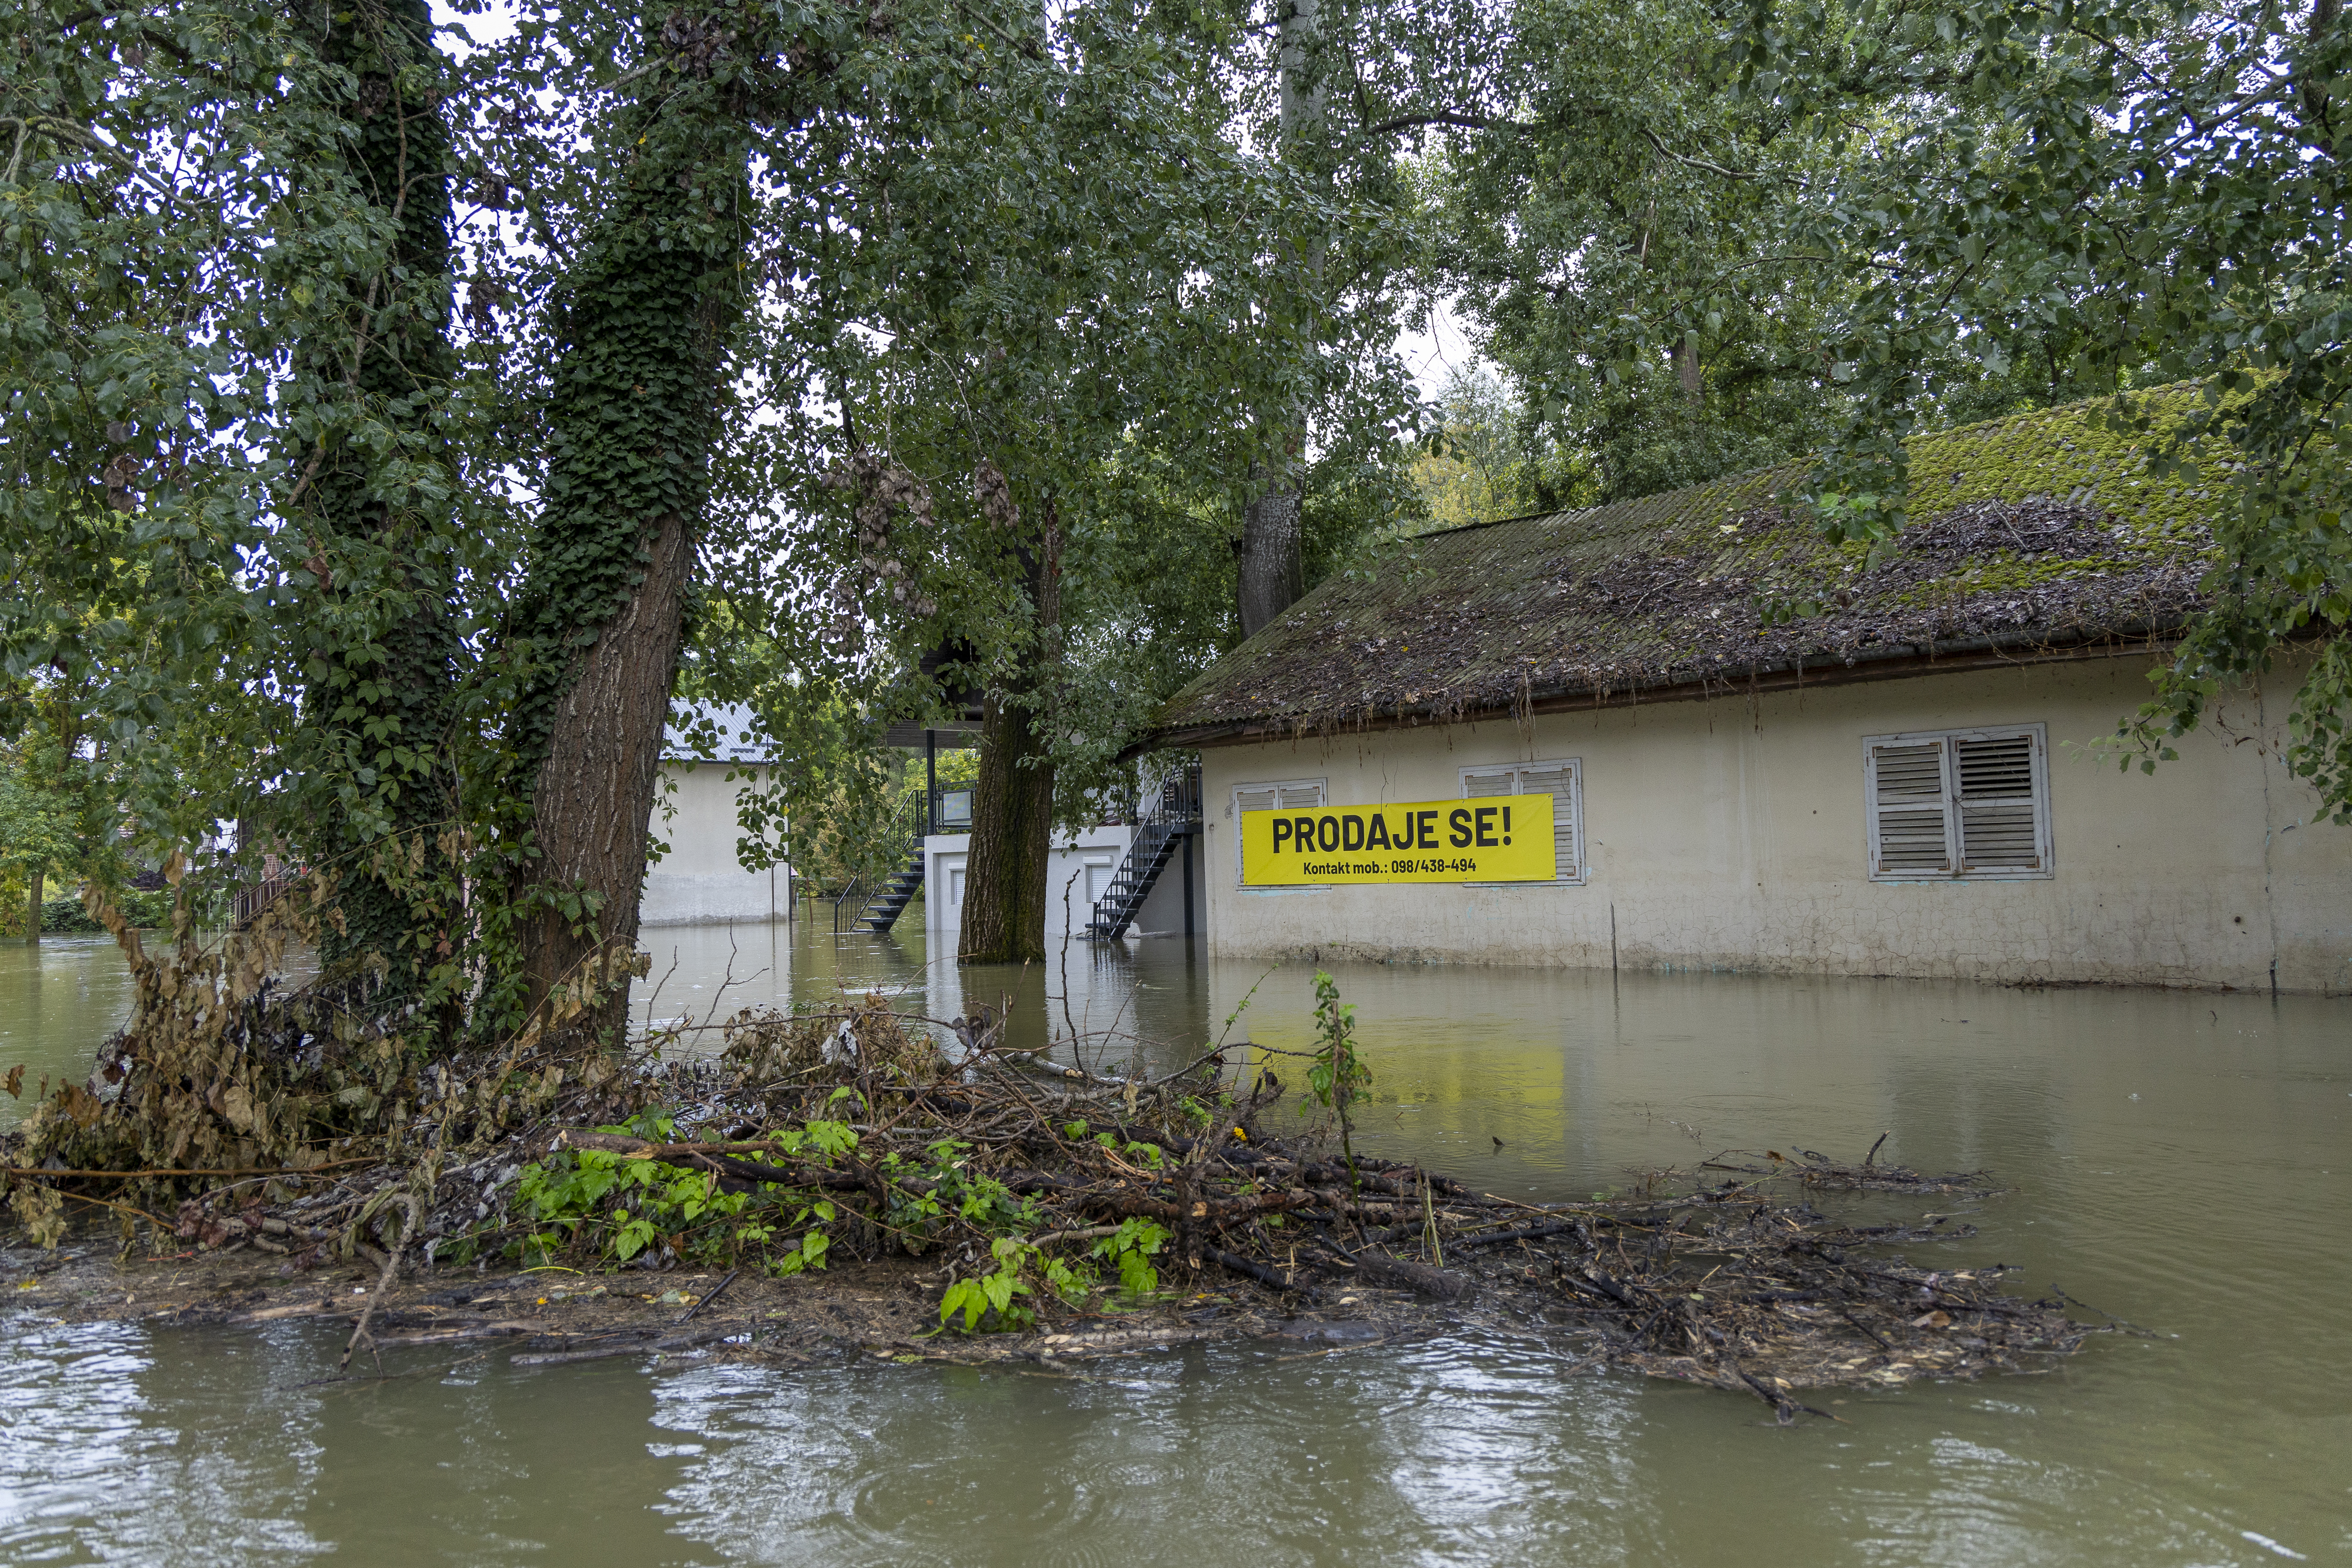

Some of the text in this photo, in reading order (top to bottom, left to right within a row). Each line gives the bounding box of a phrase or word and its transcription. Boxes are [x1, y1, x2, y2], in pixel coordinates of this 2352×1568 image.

[1272, 805, 1512, 854] PRODAJE SE!
[1303, 858, 1477, 875] Kontakt mob.: 098/438-494
